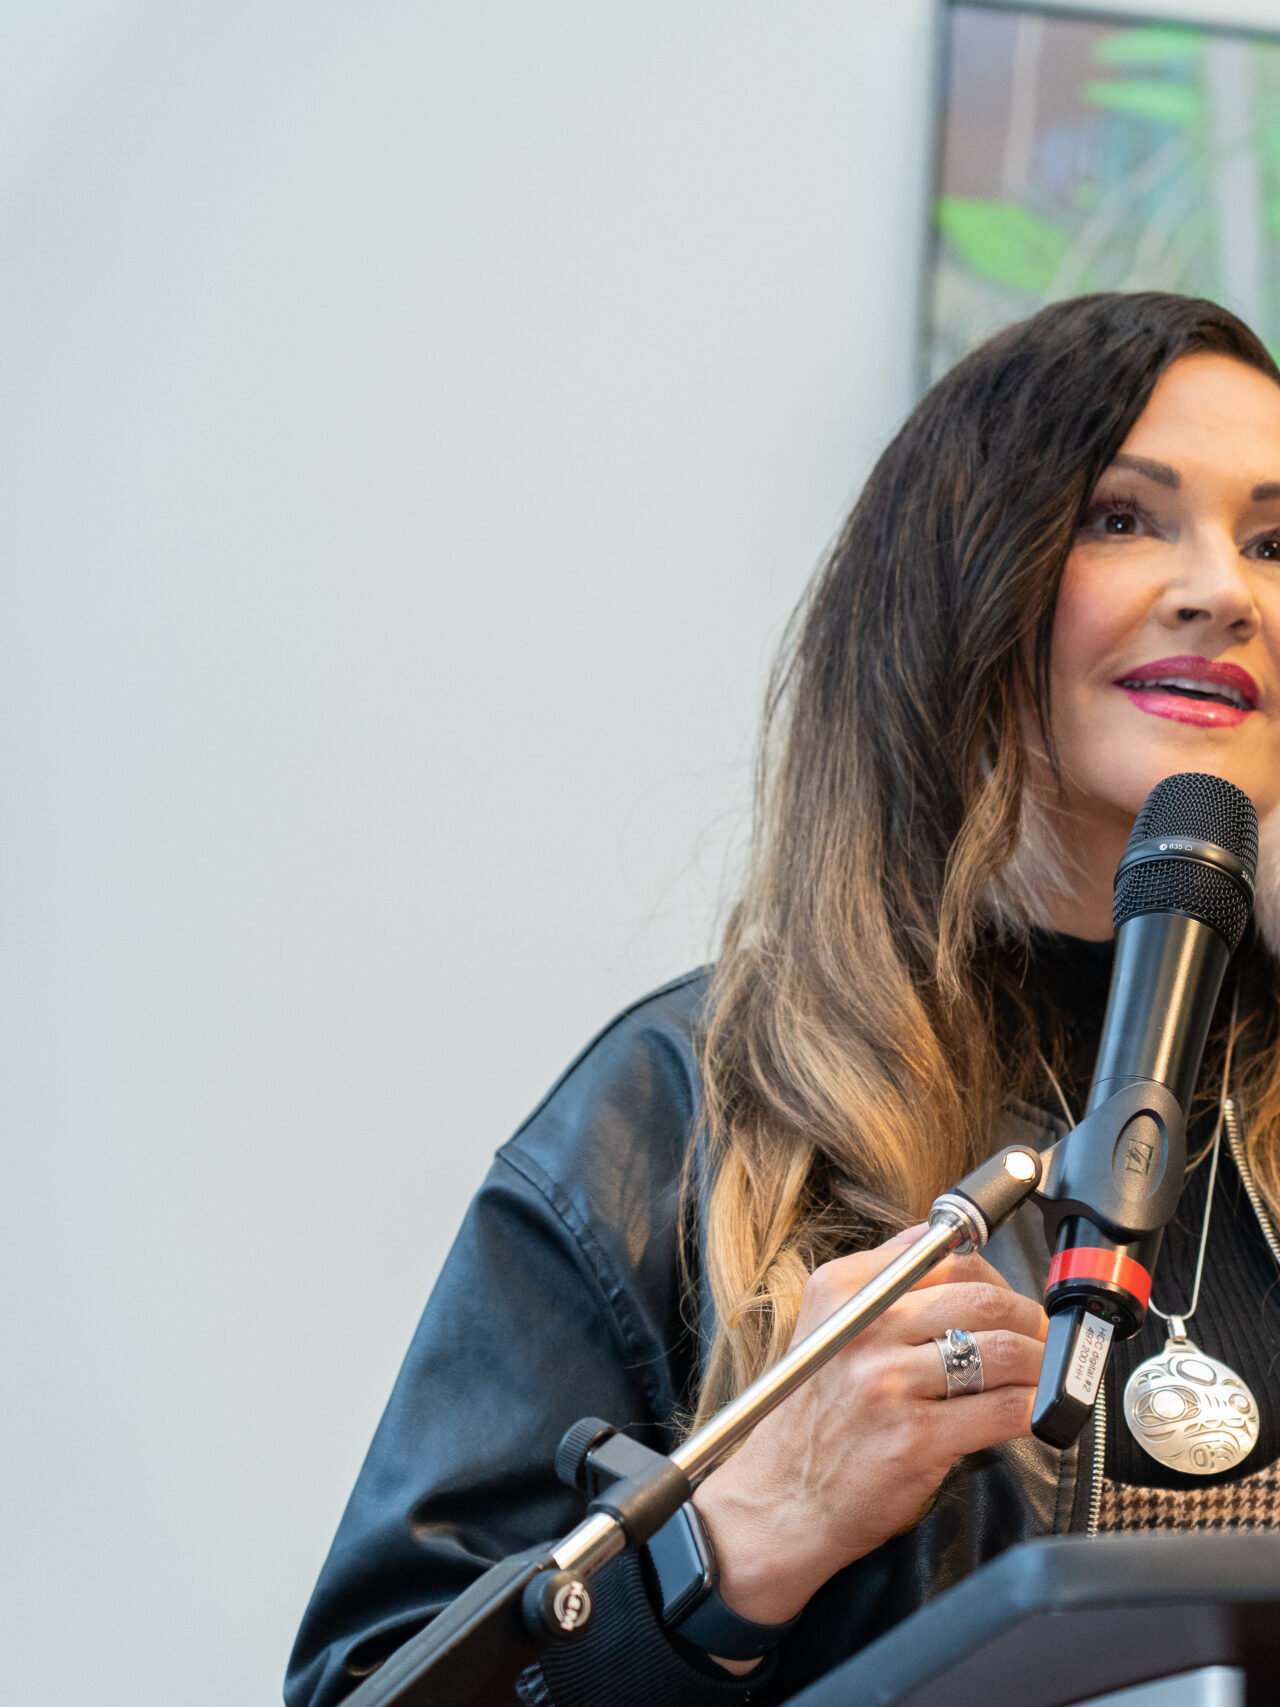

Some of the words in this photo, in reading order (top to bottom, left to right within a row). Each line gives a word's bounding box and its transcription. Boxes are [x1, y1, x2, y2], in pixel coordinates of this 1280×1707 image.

[1079, 1327, 1094, 1363] 497.200
[1095, 1327, 1107, 1350] HCC
[1074, 1365, 1083, 1380] HH
[1087, 1351, 1099, 1379] digital
[1083, 1379, 1092, 1393] #2
